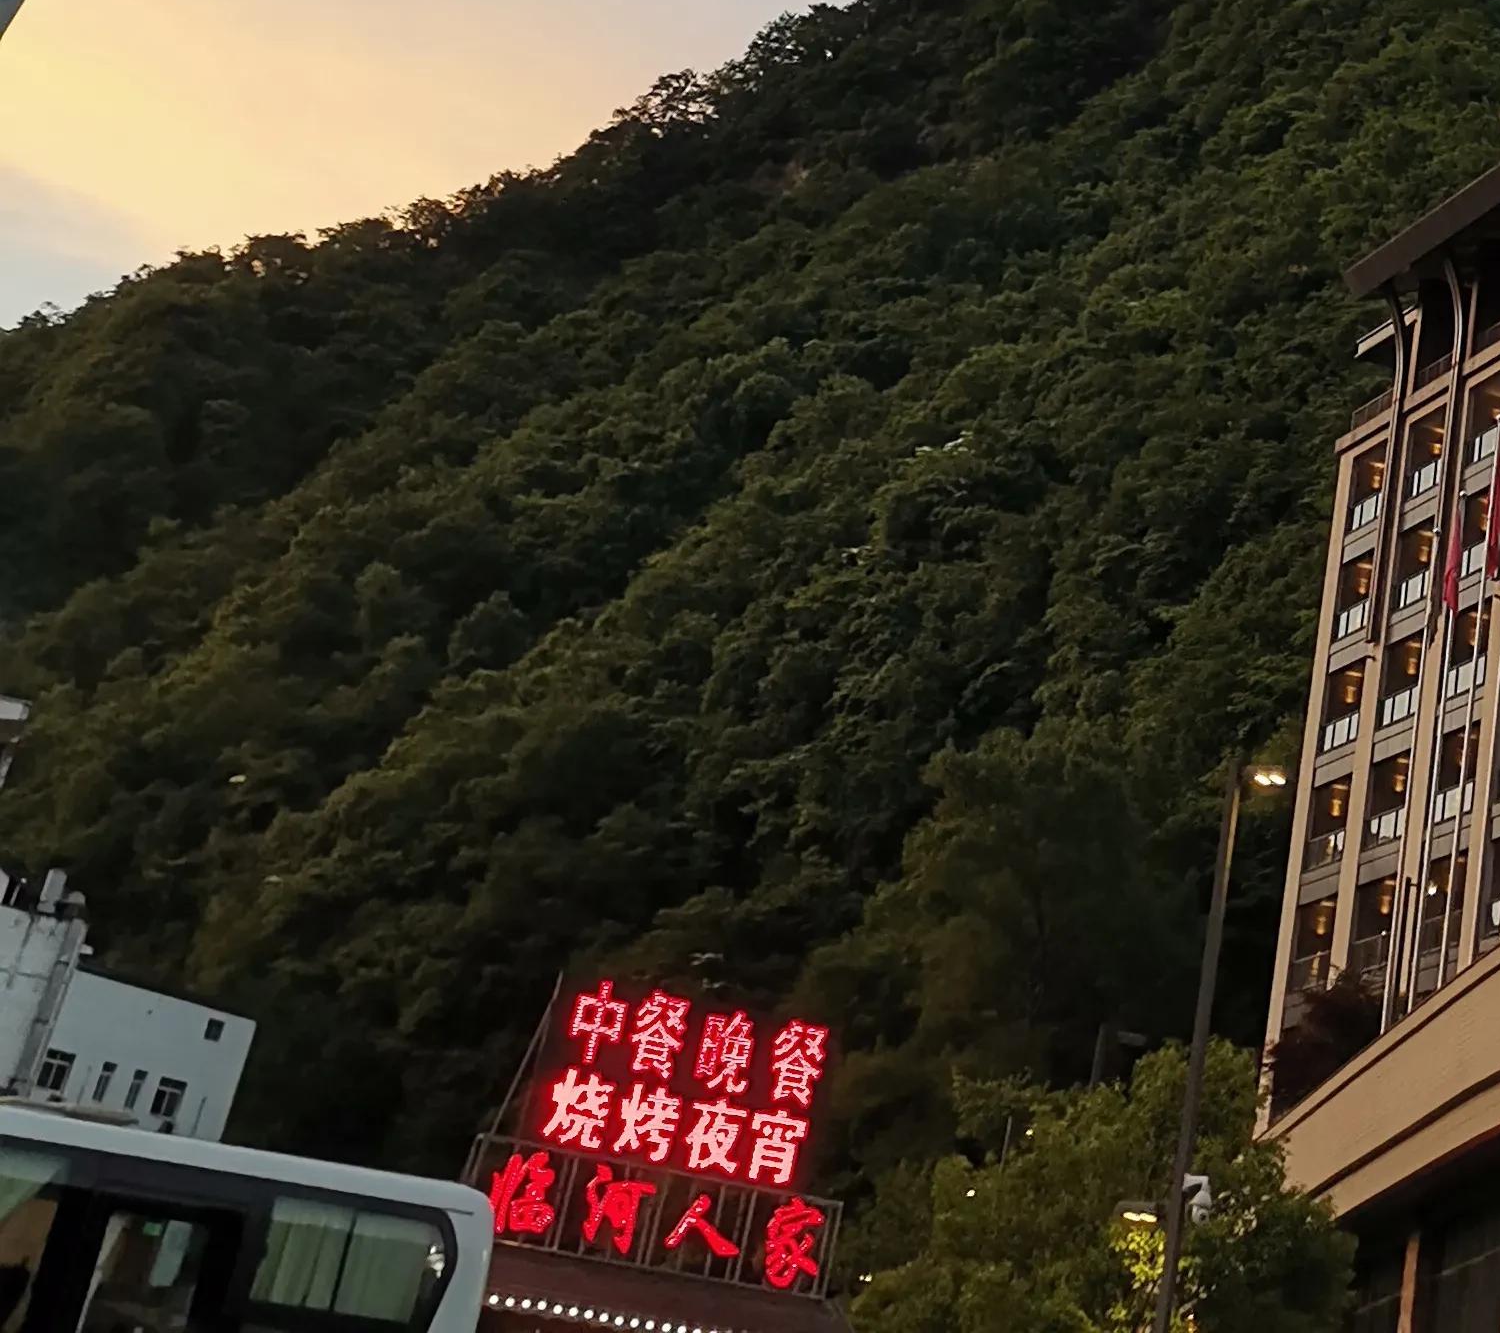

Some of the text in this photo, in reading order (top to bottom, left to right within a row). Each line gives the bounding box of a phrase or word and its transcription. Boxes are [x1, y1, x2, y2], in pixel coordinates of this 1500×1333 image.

[571, 980, 829, 1106] 中餐晚餐
[542, 1068, 807, 1185] 烧烤夜宵
